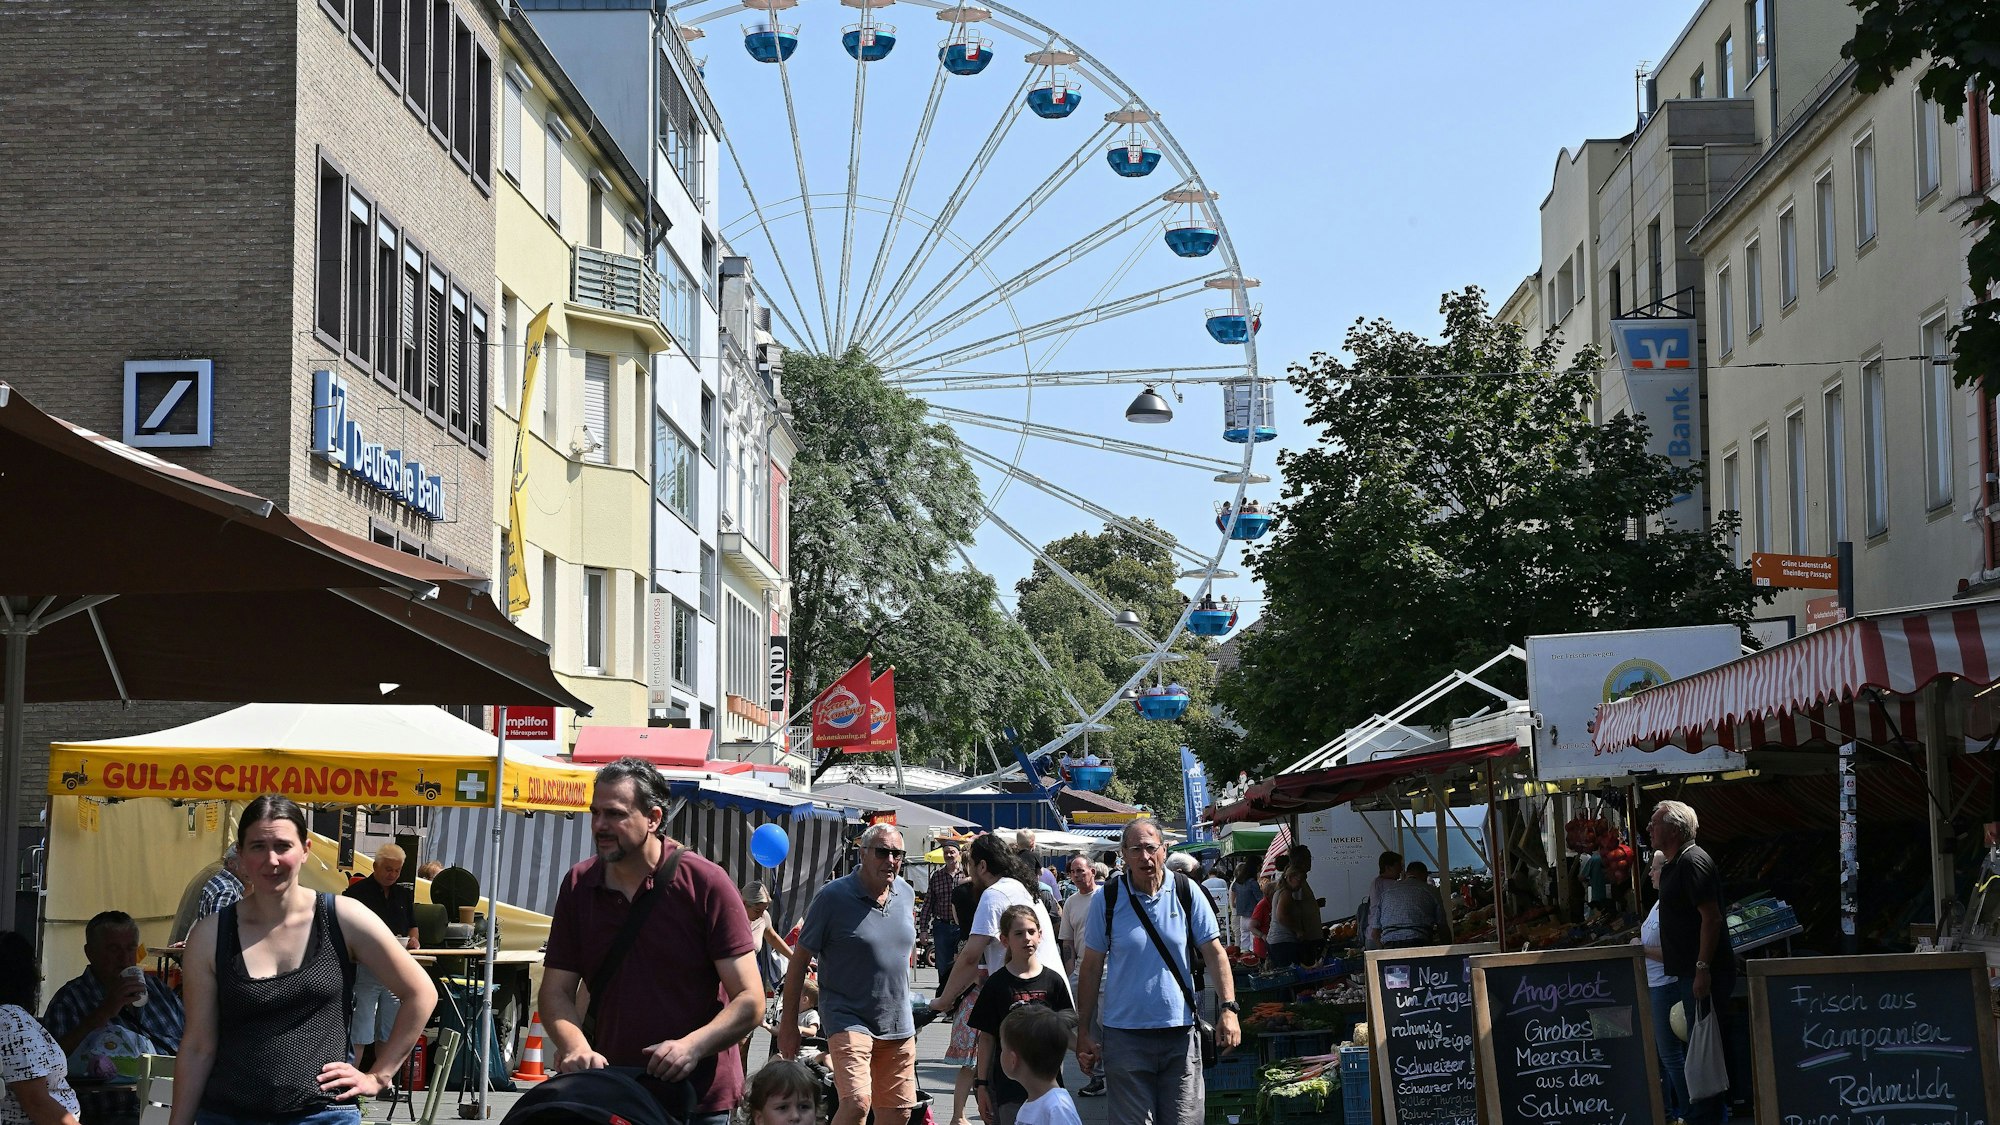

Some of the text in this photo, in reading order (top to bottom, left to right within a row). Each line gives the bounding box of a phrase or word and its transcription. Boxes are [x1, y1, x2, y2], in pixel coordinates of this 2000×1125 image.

[1666, 387, 1691, 457] Bank
[354, 421, 447, 521] Deutsche Bank
[1781, 560, 1832, 569] Grüne Ladenstraße
[1810, 570, 1832, 579] Passage
[652, 598, 661, 687] lernstudiobarbarossa
[771, 645, 784, 700] KIND
[506, 716, 548, 728] mplifon
[818, 704, 867, 725] Koning
[102, 762, 399, 797] GULASCHKANONE
[528, 776, 587, 805] GULASCHKANONE
[1330, 836, 1364, 844] IMKEREI
[1418, 966, 1449, 986] Neu
[1396, 992, 1422, 1008] im
[1512, 971, 1612, 1012] Angebot
[1789, 984, 1917, 1013] Frisch aus
[1525, 1016, 1593, 1042] Grobes
[1803, 1021, 1951, 1061] Kampanien
[1416, 1033, 1472, 1052] würzige
[1516, 1041, 1604, 1067] Meersalz
[1395, 1056, 1466, 1076] Schweizer
[1397, 1082, 1454, 1095] Schwarzer
[1536, 1069, 1604, 1089] aus den
[1829, 1066, 1956, 1106] Rohmilch
[1517, 1094, 1614, 1117] Salinen
